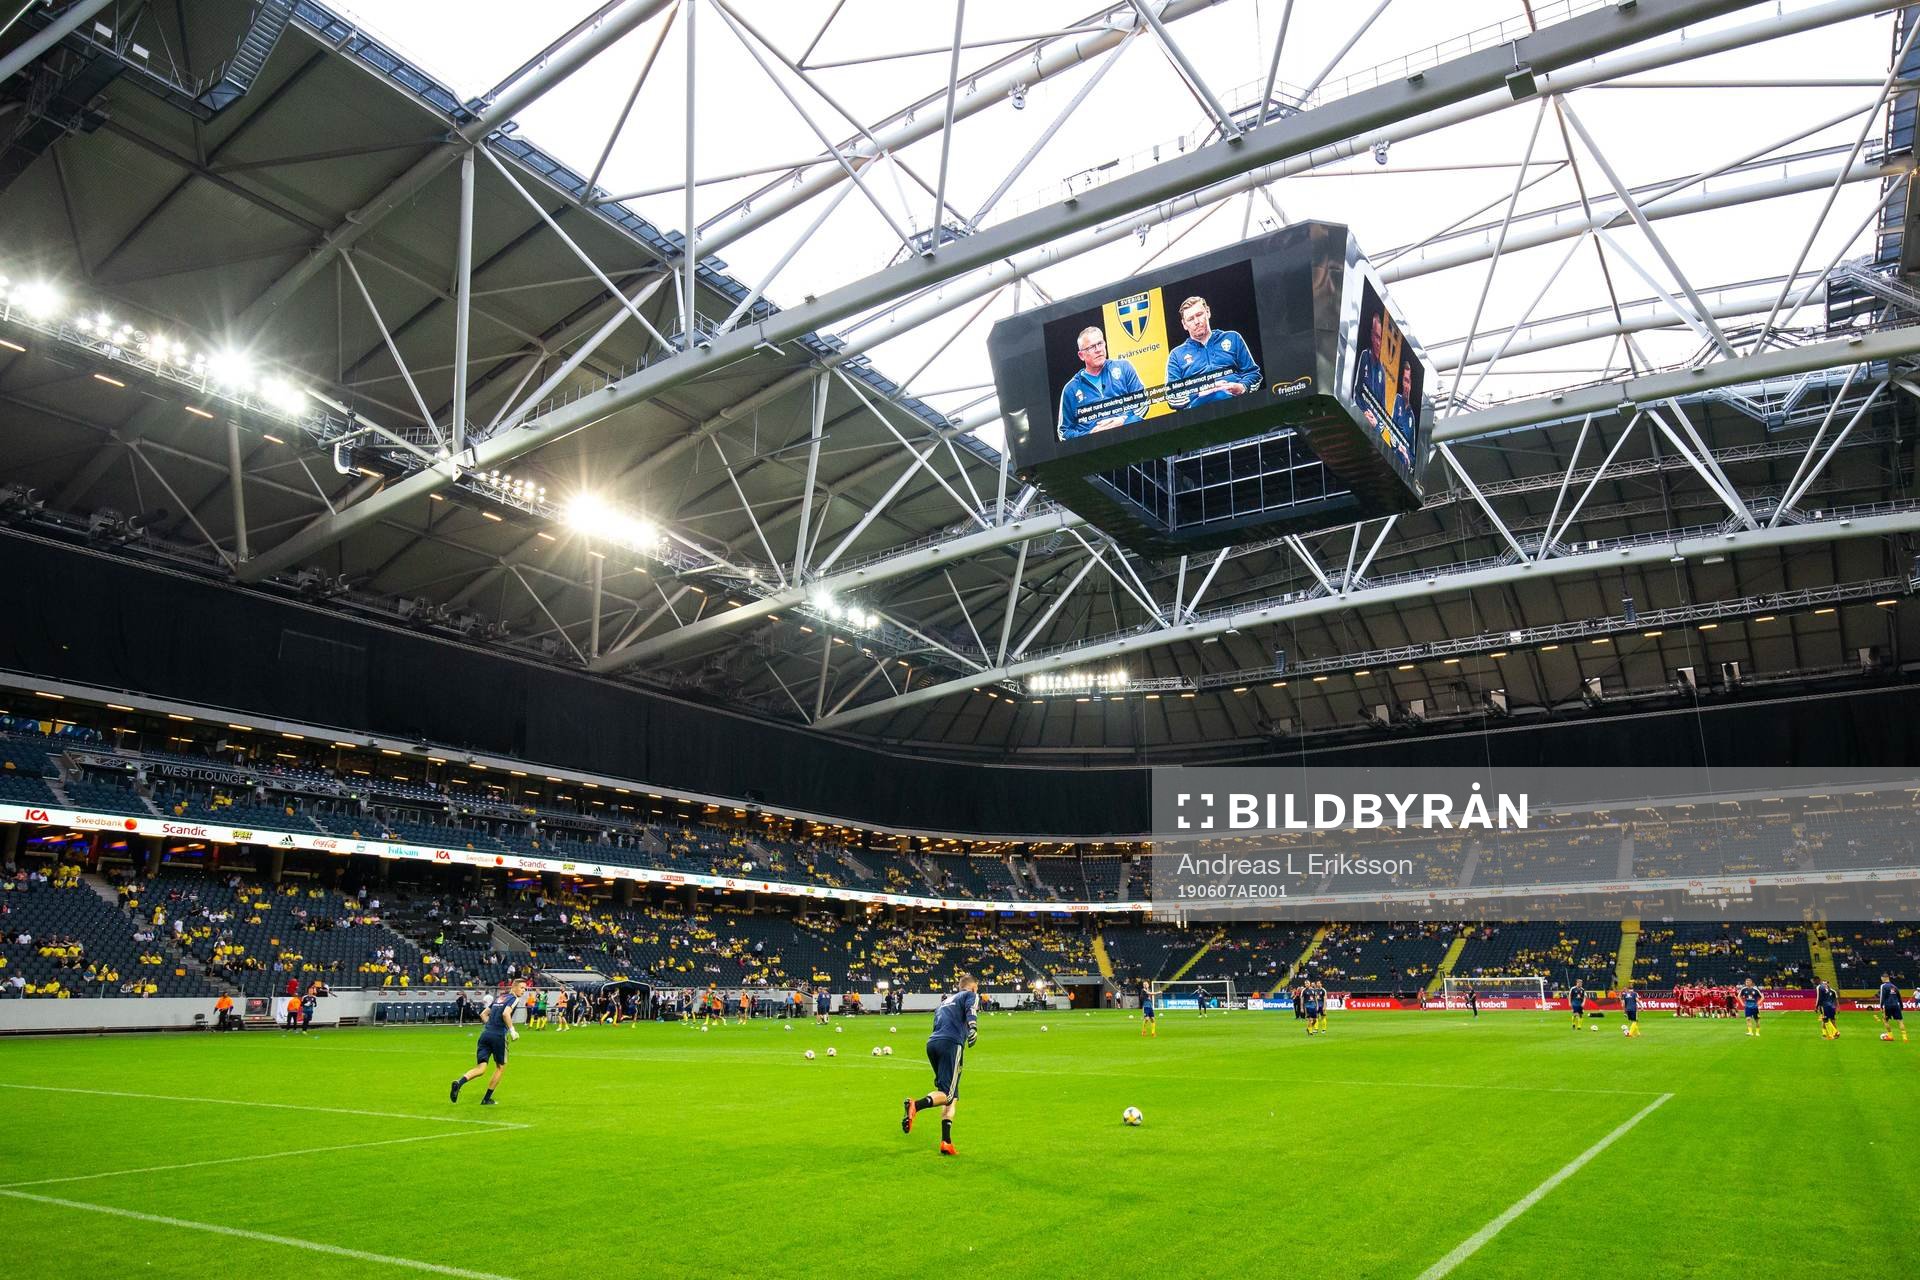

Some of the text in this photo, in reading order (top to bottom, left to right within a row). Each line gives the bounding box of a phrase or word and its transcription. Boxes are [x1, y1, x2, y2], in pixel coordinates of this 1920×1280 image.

[161, 765, 246, 785] WEST LOUNGE
[25, 809, 49, 822] ICA
[75, 815, 122, 828] Swedbank
[162, 823, 208, 837] Scandic
[436, 850, 450, 860] ICA
[519, 859, 547, 869] Scandic
